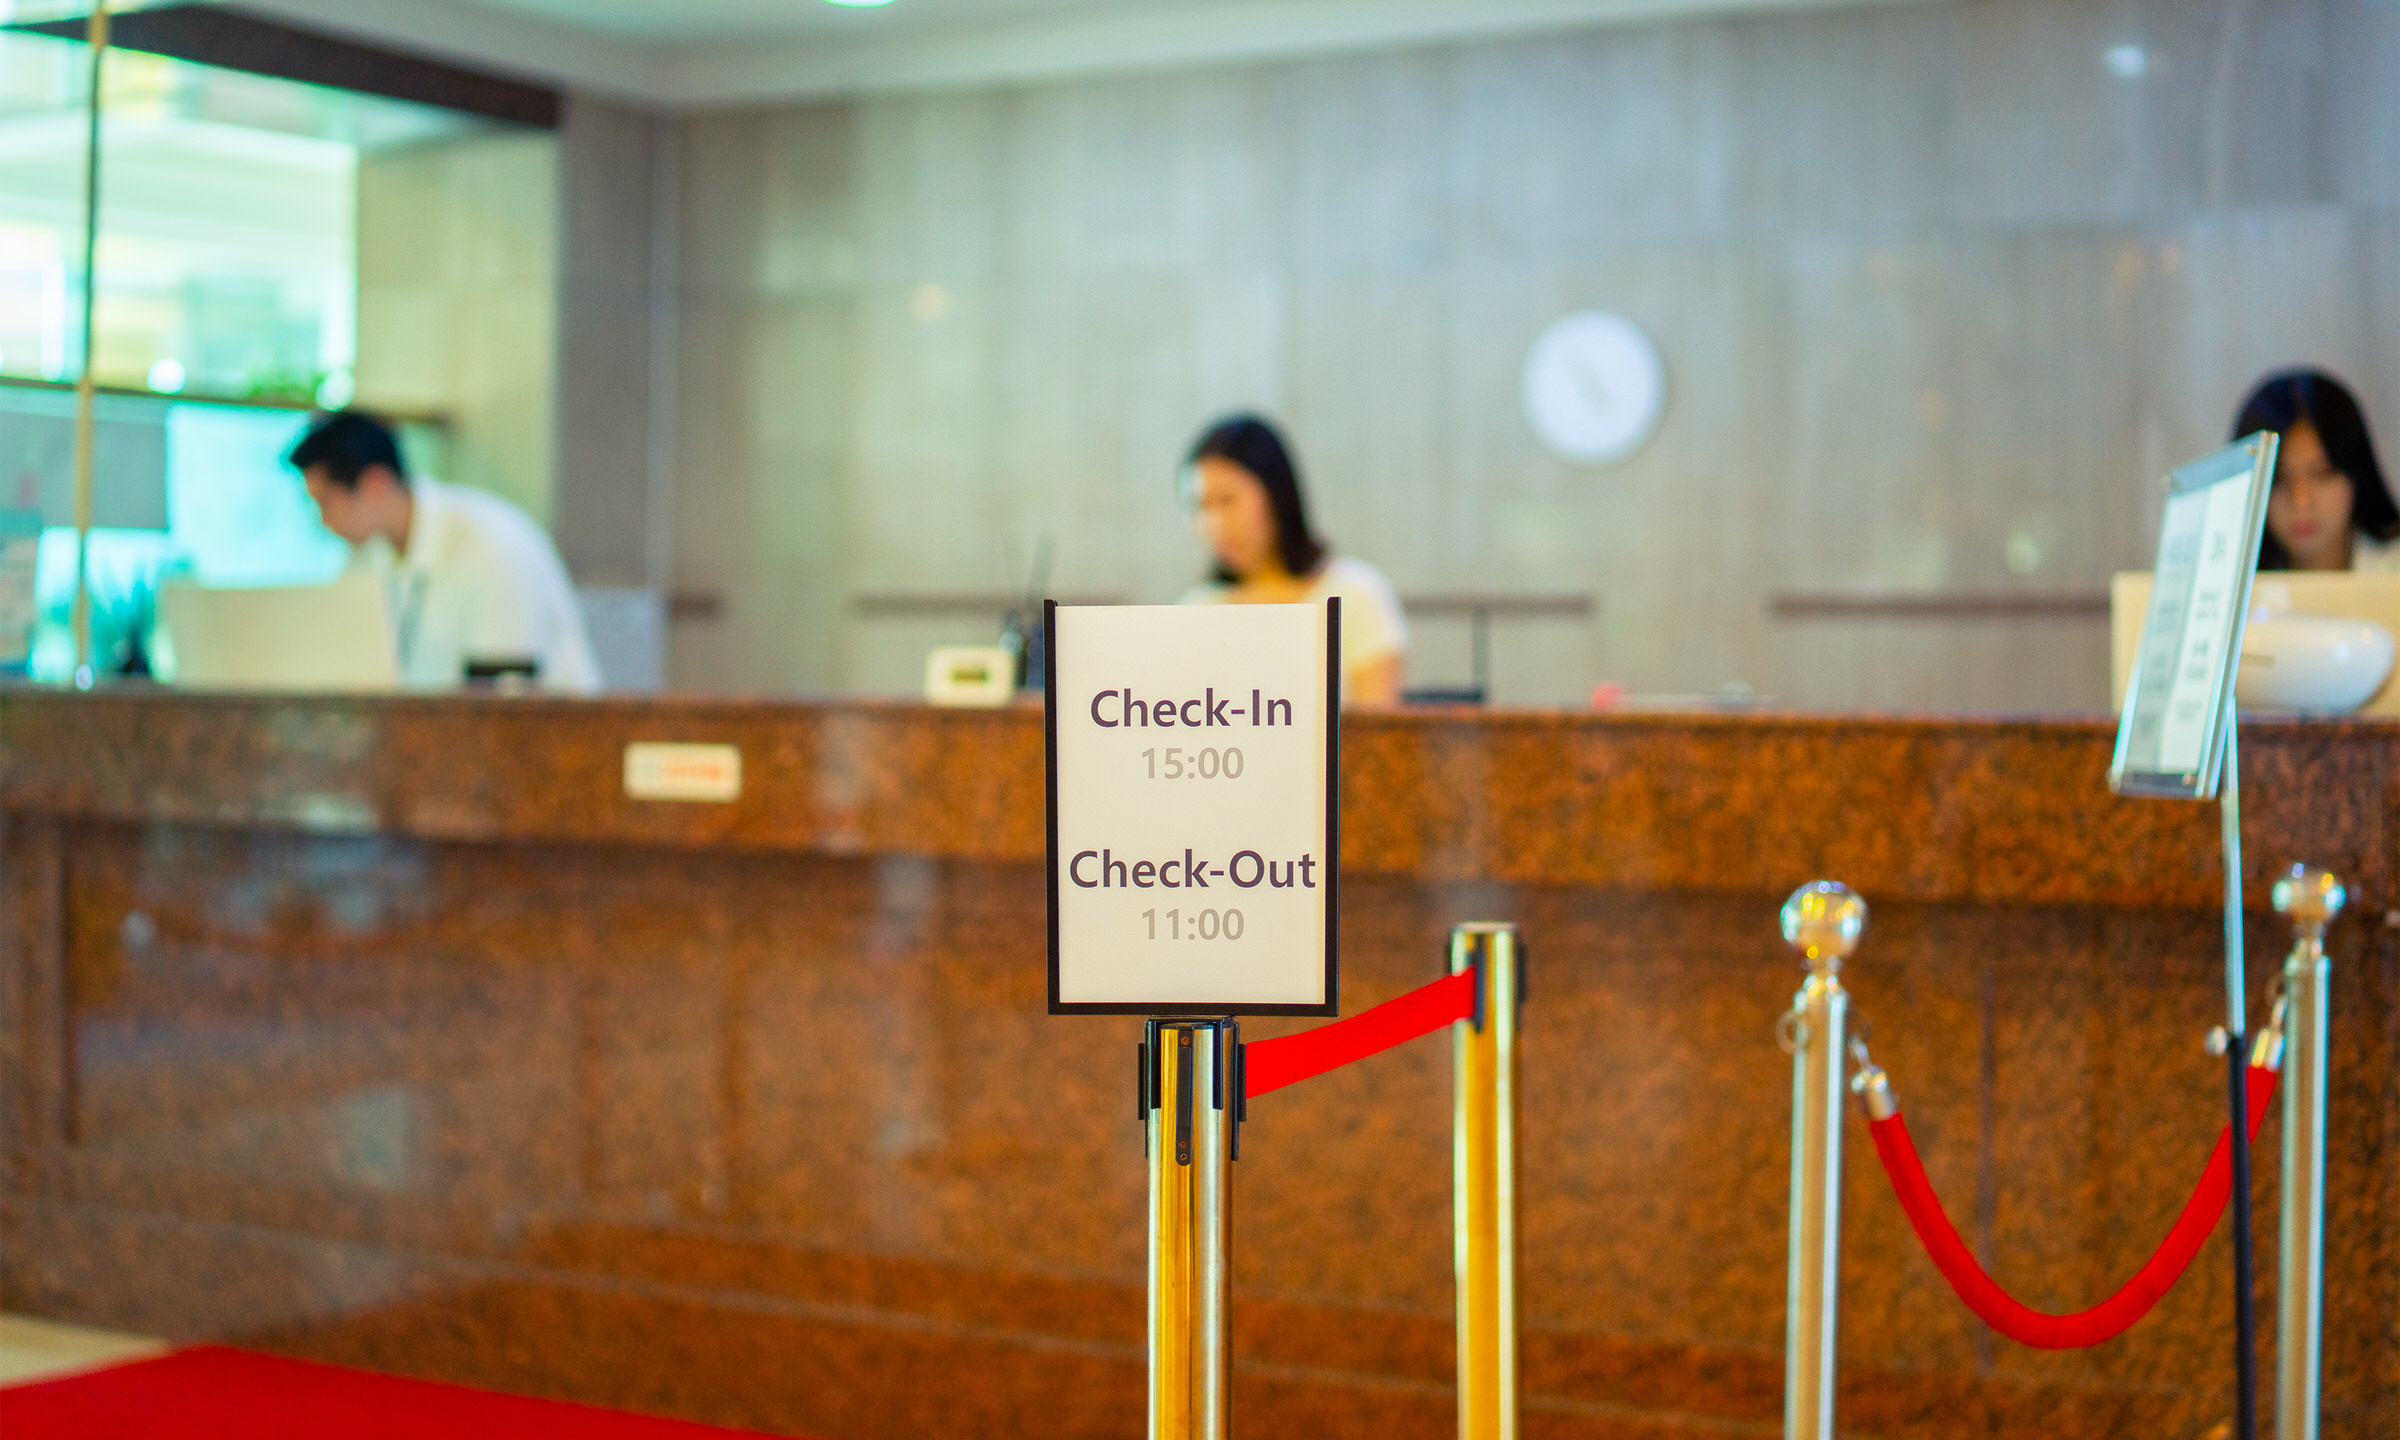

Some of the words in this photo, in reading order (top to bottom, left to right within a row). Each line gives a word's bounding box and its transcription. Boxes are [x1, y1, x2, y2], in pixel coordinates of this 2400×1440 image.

[1090, 687, 1293, 728] Check-In
[1142, 747, 1245, 779] 15:00
[1069, 848, 1316, 889] Check-Out
[1142, 908, 1245, 940] 11:00
